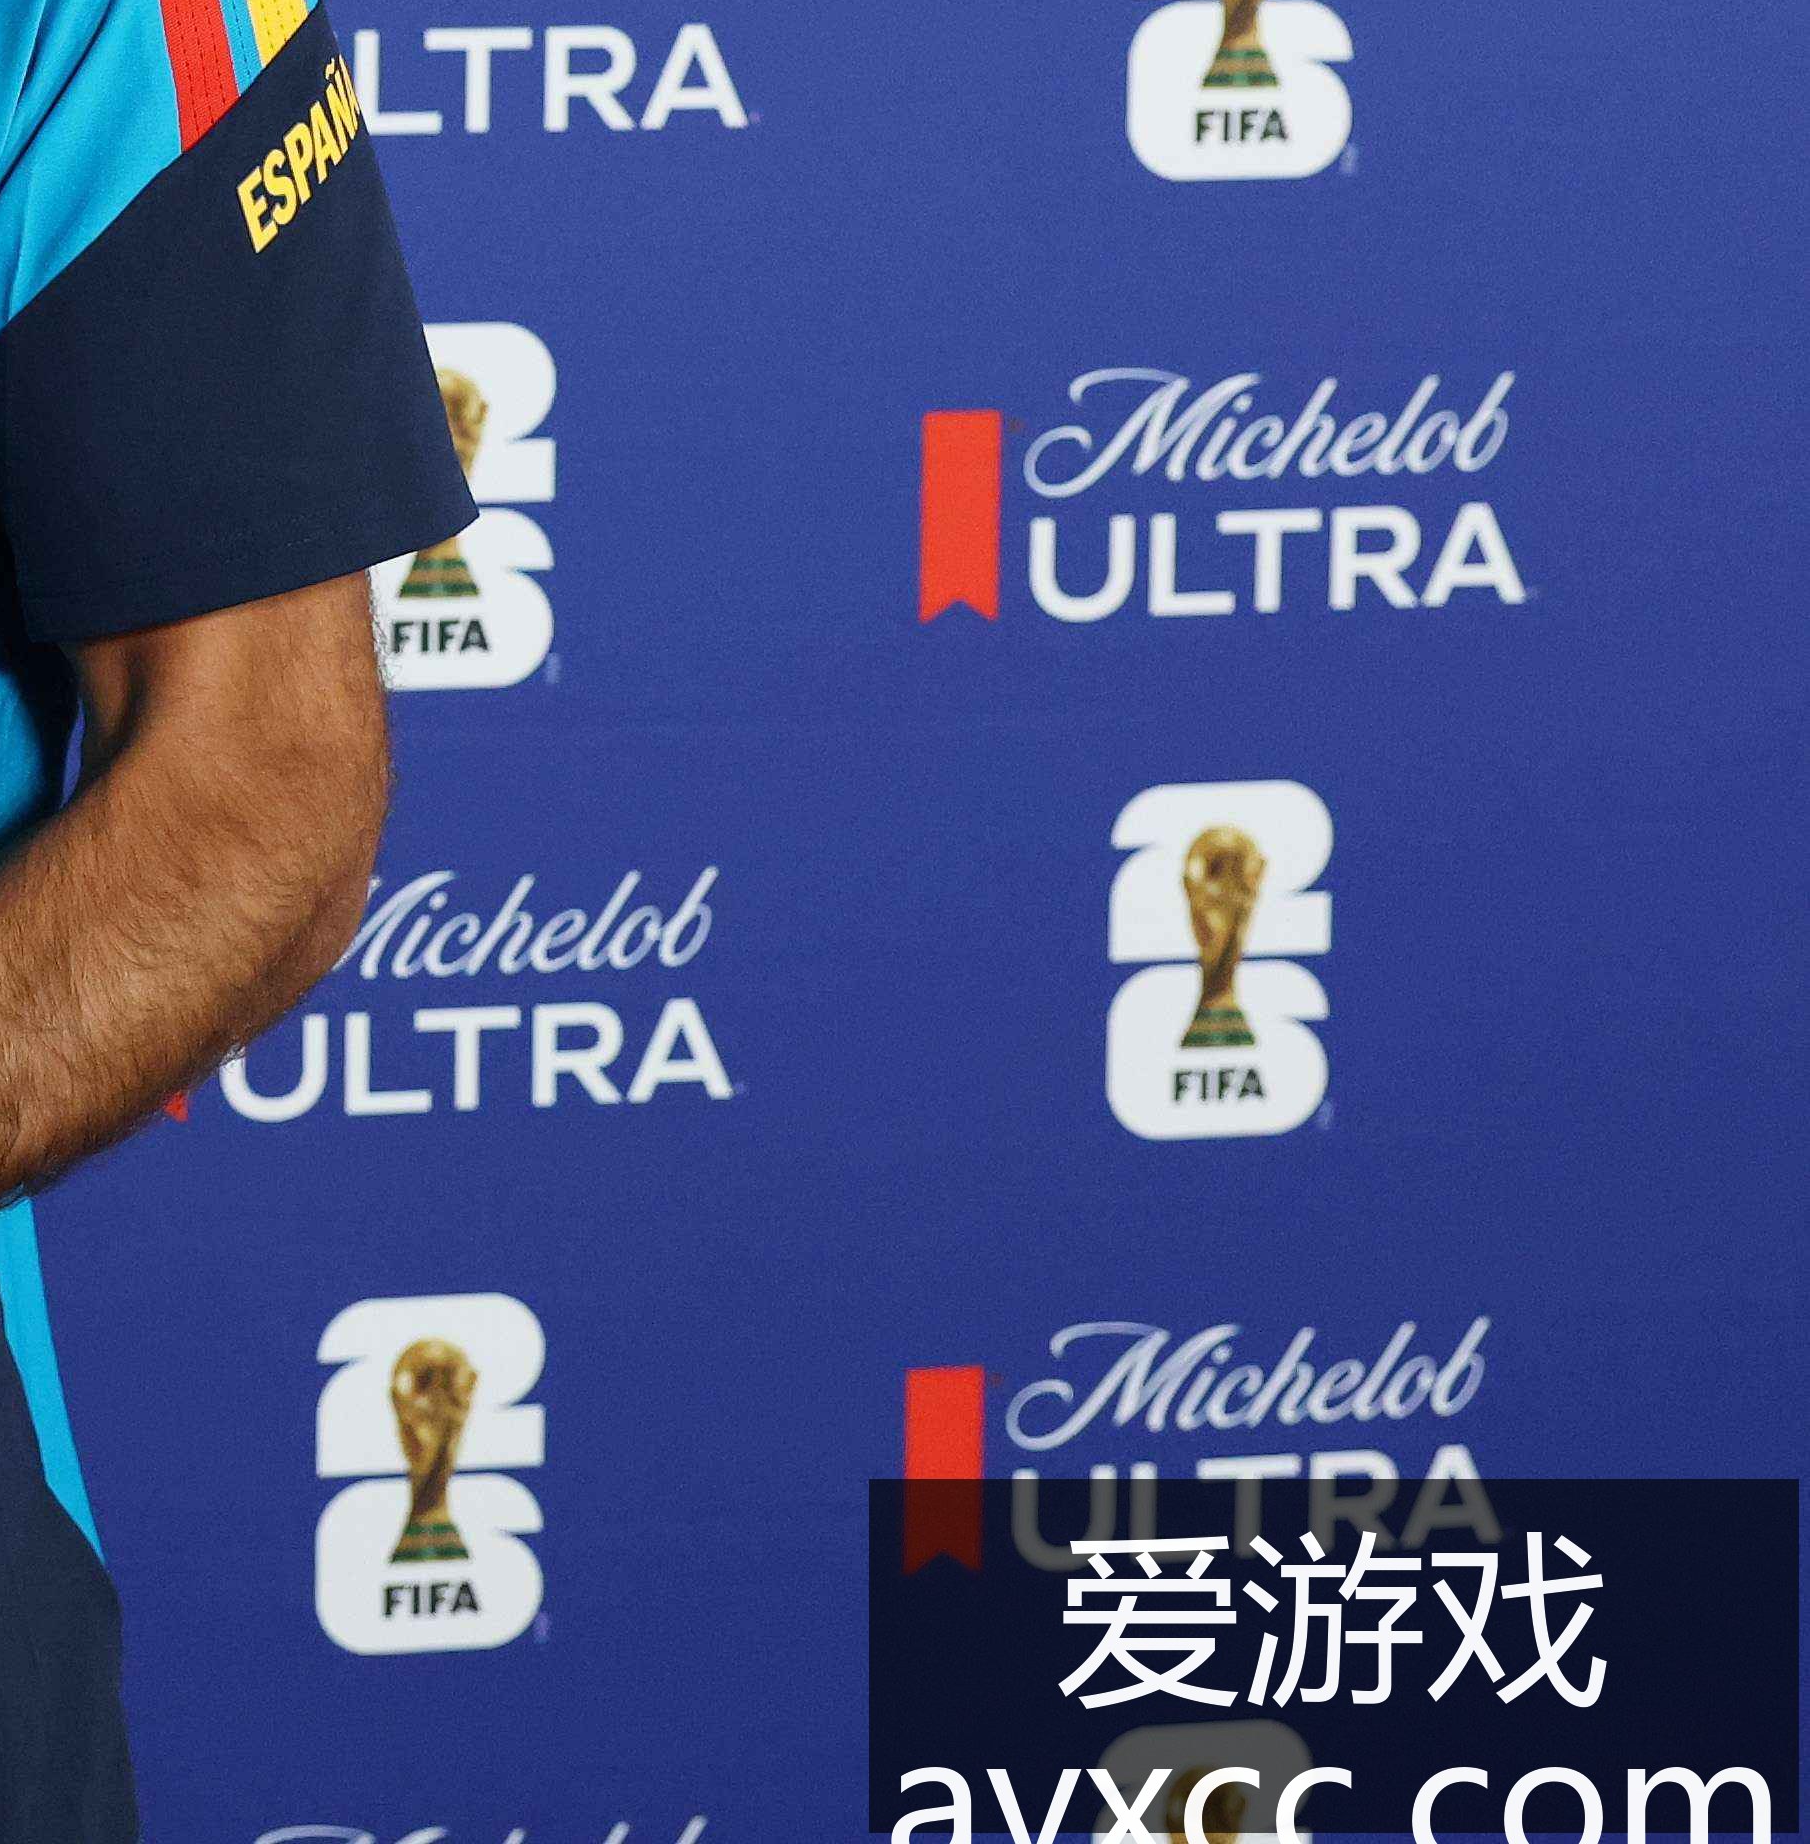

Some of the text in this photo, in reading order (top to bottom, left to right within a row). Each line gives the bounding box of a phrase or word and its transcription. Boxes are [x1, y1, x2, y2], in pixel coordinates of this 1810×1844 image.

[354, 24, 748, 135] LTRA
[1194, 109, 1289, 144] FIFA
[1024, 368, 1514, 497] Michelob
[1029, 502, 1526, 622] ULTRA
[391, 619, 490, 654] FIFA
[219, 998, 733, 1123] ULTRA
[1173, 1068, 1265, 1102] FIFA
[1007, 1316, 1490, 1451] Michelob
[383, 1581, 480, 1618] FIFA
